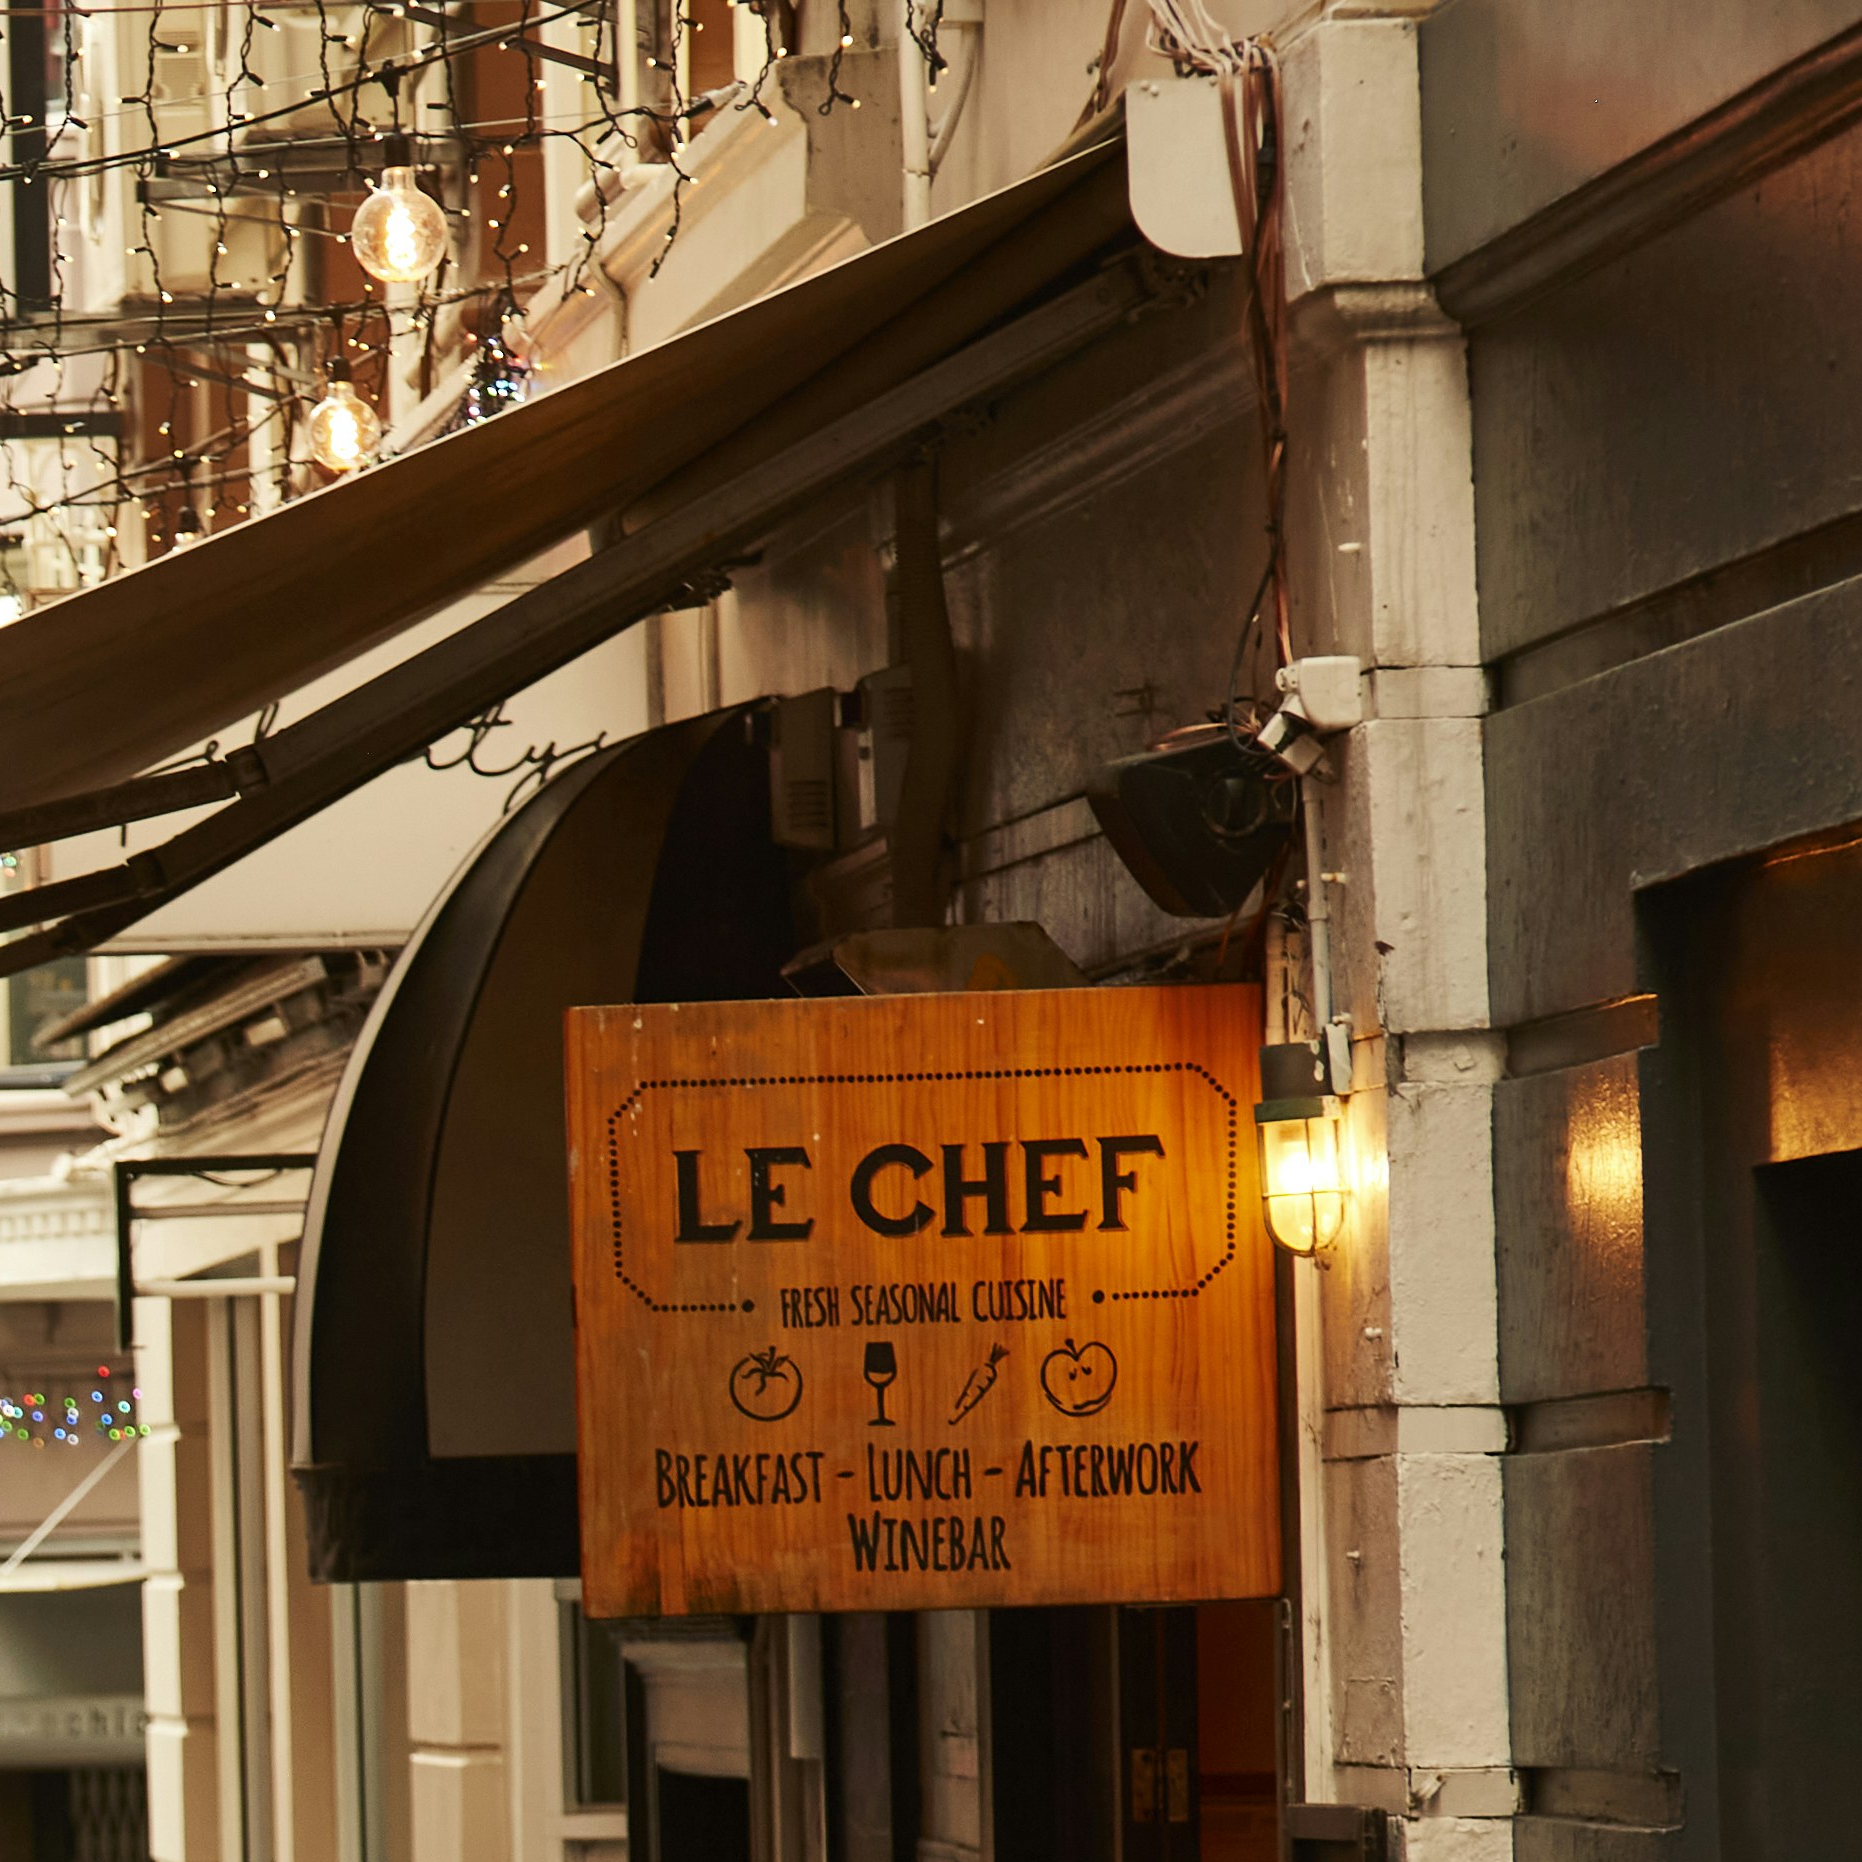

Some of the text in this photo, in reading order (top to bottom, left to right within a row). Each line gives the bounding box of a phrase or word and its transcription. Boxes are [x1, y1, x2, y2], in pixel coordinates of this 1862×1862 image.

[672, 1134, 1166, 1243] LE CHEF
[780, 1278, 1067, 1329] FRESH SEASONAL CUISINE
[655, 1447, 825, 1508] BREAKFAST
[866, 1441, 973, 1501] LUNCH
[1014, 1440, 1203, 1498] AFTERWORK
[847, 1510, 1012, 1573] WINEBAR
